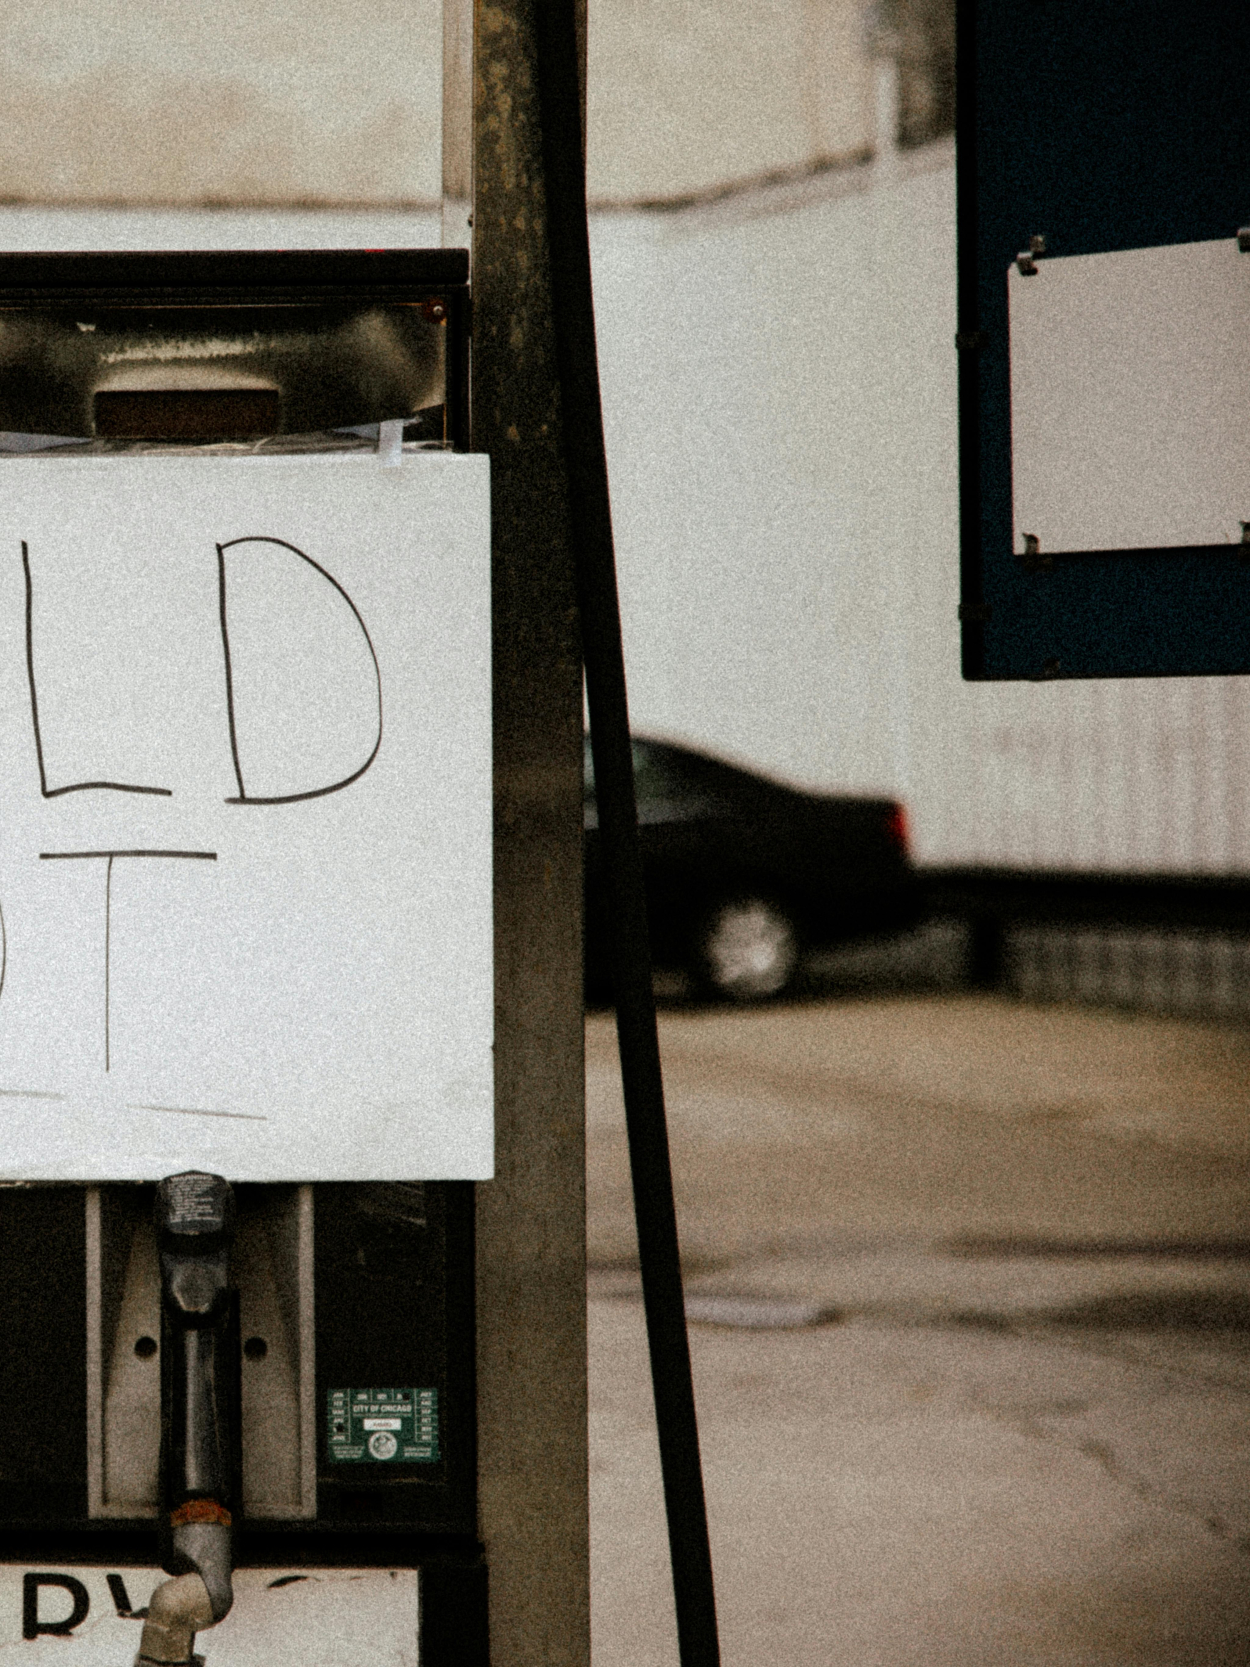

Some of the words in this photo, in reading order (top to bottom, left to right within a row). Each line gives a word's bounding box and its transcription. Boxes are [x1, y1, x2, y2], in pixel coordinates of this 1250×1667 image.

[352, 1404, 369, 1413] CITY
[369, 1404, 379, 1413] OF
[380, 1404, 412, 1413] CHICAGO
